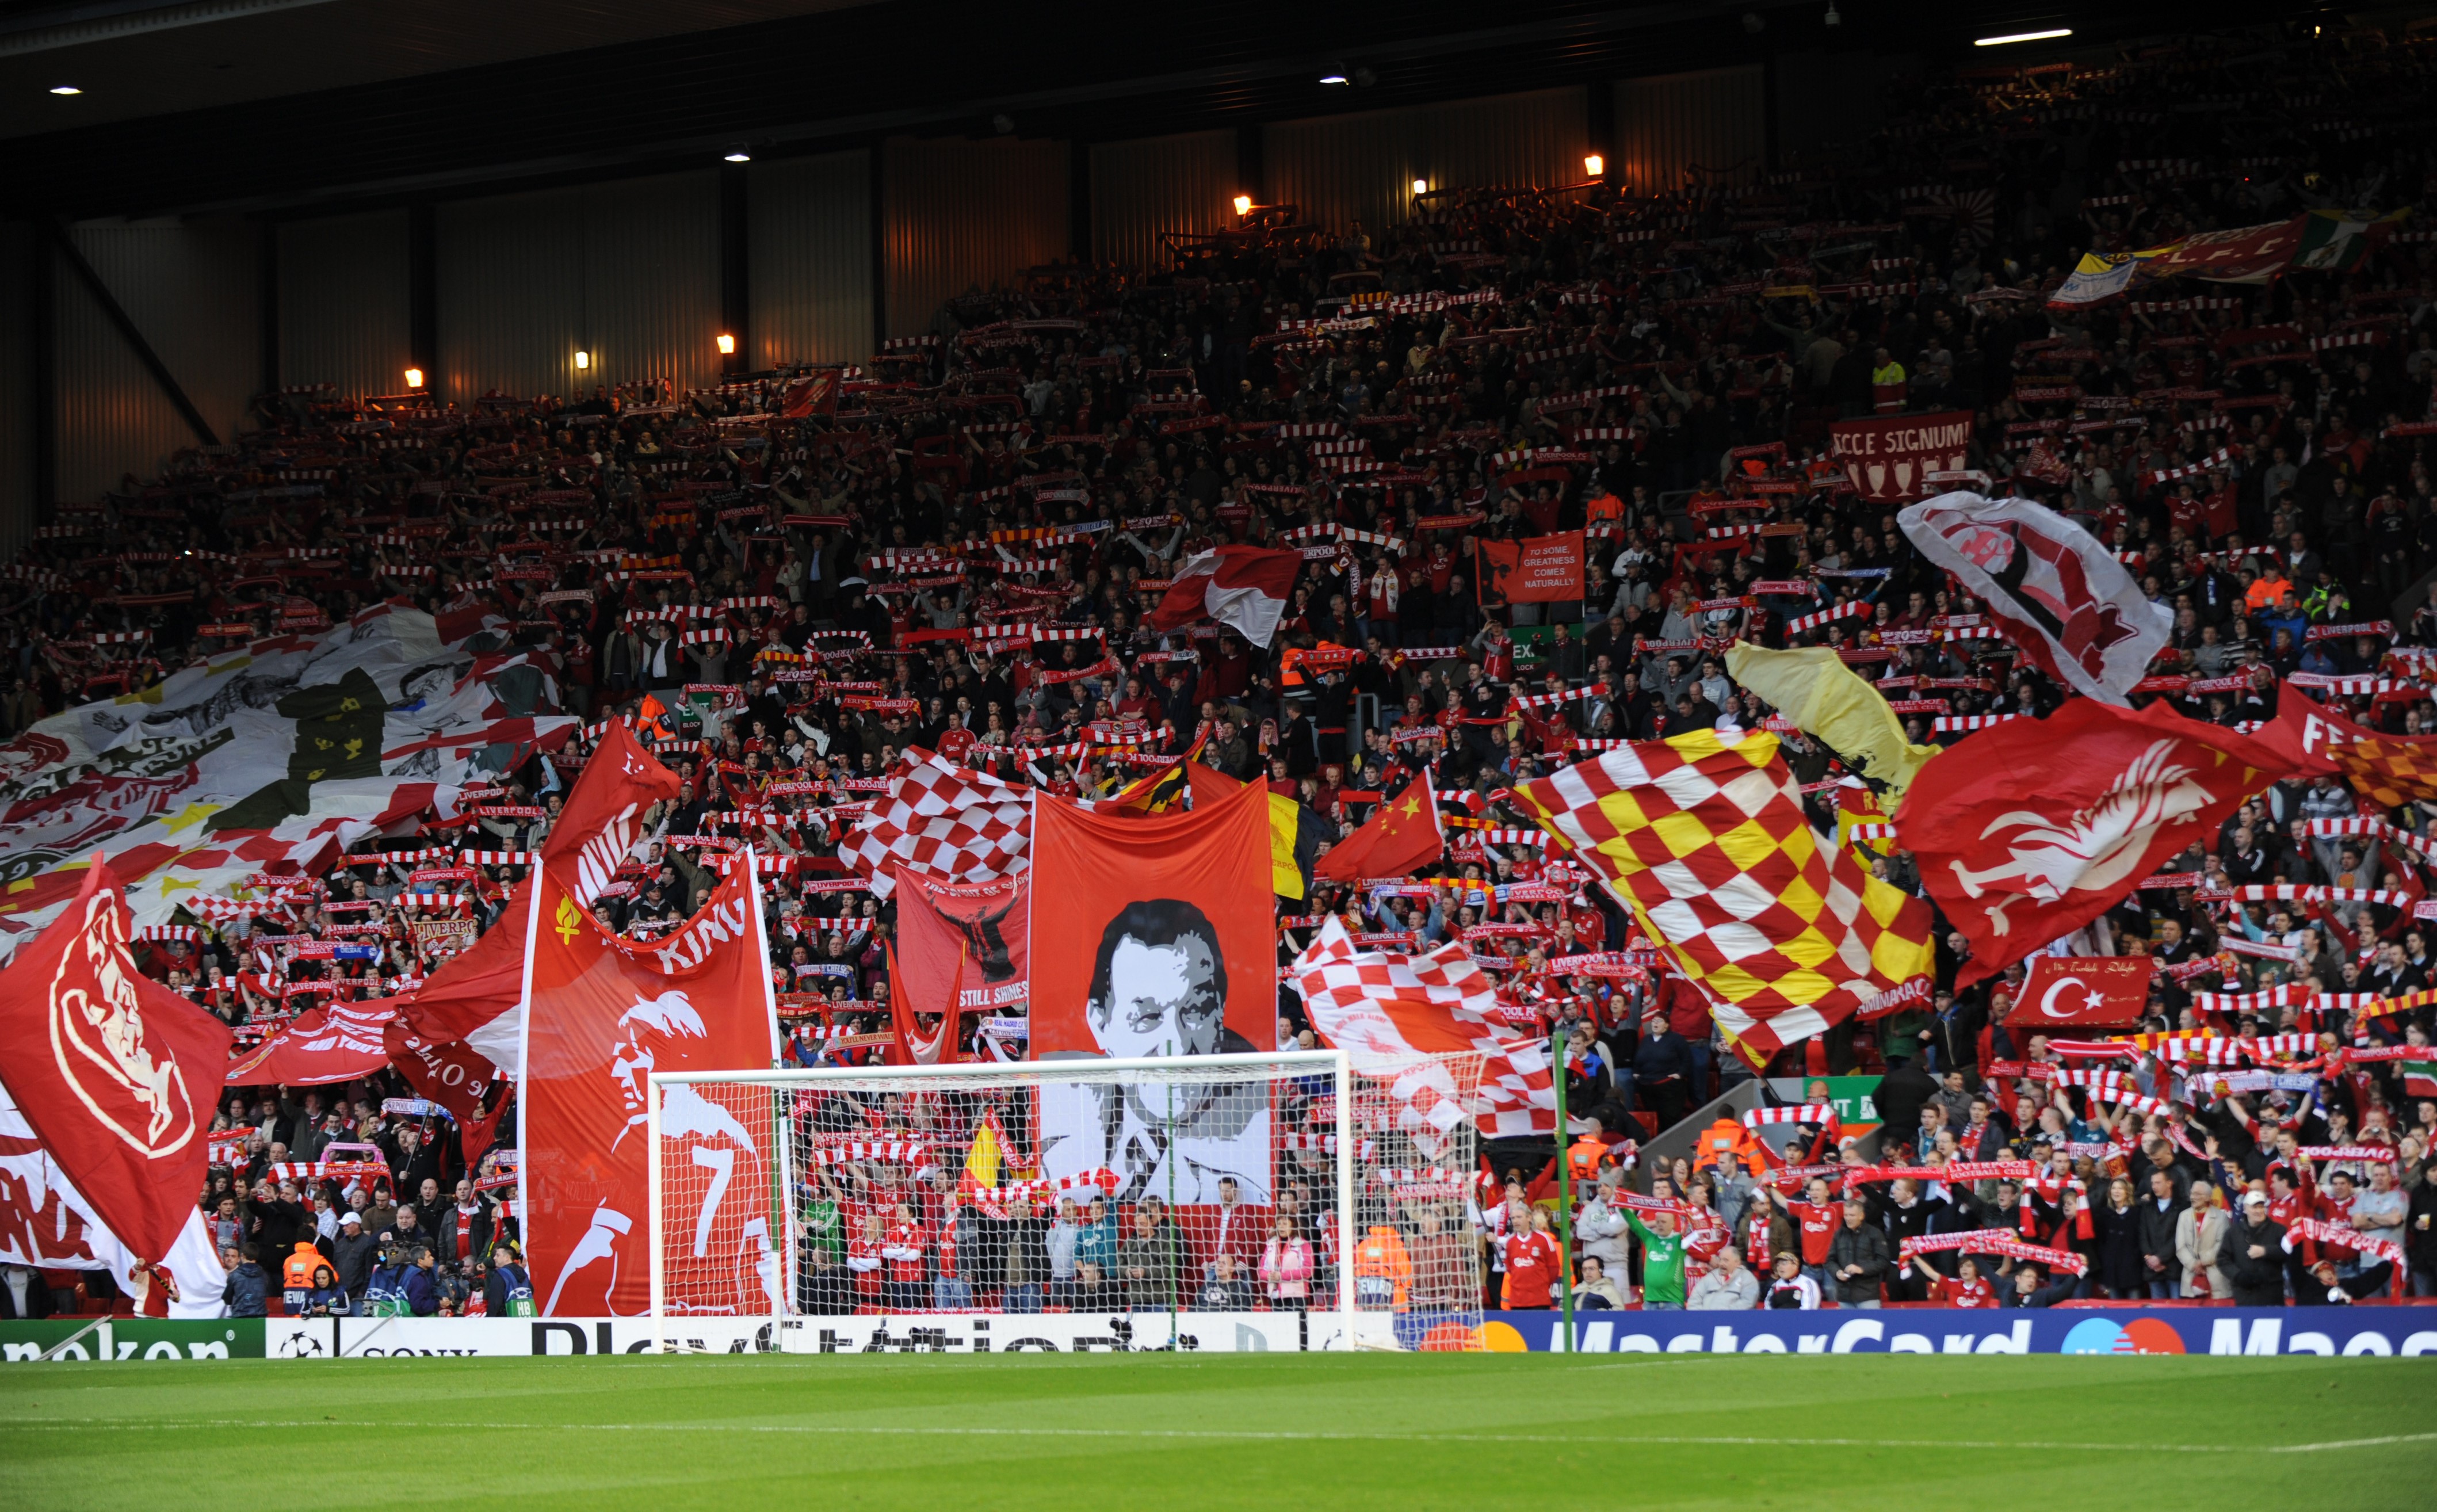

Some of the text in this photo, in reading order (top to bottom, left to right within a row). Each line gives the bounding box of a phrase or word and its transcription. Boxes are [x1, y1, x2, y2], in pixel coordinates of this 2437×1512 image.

[1884, 421, 1970, 453] SIGNUM!
[721, 505, 765, 517] LIVERPOOL FC
[1530, 545, 1570, 556] TO SOME,
[1523, 556, 1575, 567] GREATNESS
[1534, 568, 1565, 577] COMES
[1525, 578, 1575, 588] NATURALLY
[1700, 598, 1740, 607] LIVERPOOL
[2322, 623, 2371, 636] LIVERPOOL
[1643, 639, 1698, 648] LIVERPOOL
[1069, 664, 1098, 677] LIVERPOOL
[820, 679, 878, 689] LIVERPOOL
[724, 692, 734, 707] 9
[874, 700, 913, 708] LIVERPOOL
[770, 781, 813, 792] LIVERPOOL
[858, 780, 890, 789] VERPOOL
[480, 806, 538, 815] LIVERPOOL
[415, 872, 456, 881] LIVERPOOL
[1362, 877, 1404, 887] LIVERPOOL
[653, 896, 746, 975] KING
[1361, 933, 1396, 941] LIVERPOOL
[959, 980, 1028, 1007] STILL SHINES
[832, 1001, 865, 1009] LIVERPOOL
[858, 1033, 878, 1043] NEVER
[2350, 1045, 2405, 1059] LIVERPOOL FC
[2298, 1146, 2390, 1159] LIVERPOOL
[1948, 1160, 2030, 1174] LIVERPOOL
[482, 1173, 518, 1185] THE MIGHT
[1951, 1168, 2000, 1180] FOOTBALL
[692, 1146, 734, 1258] 7
[1627, 1196, 1664, 1208] LIVERPOOL
[1985, 1241, 2062, 1264] LIVERPOOL
